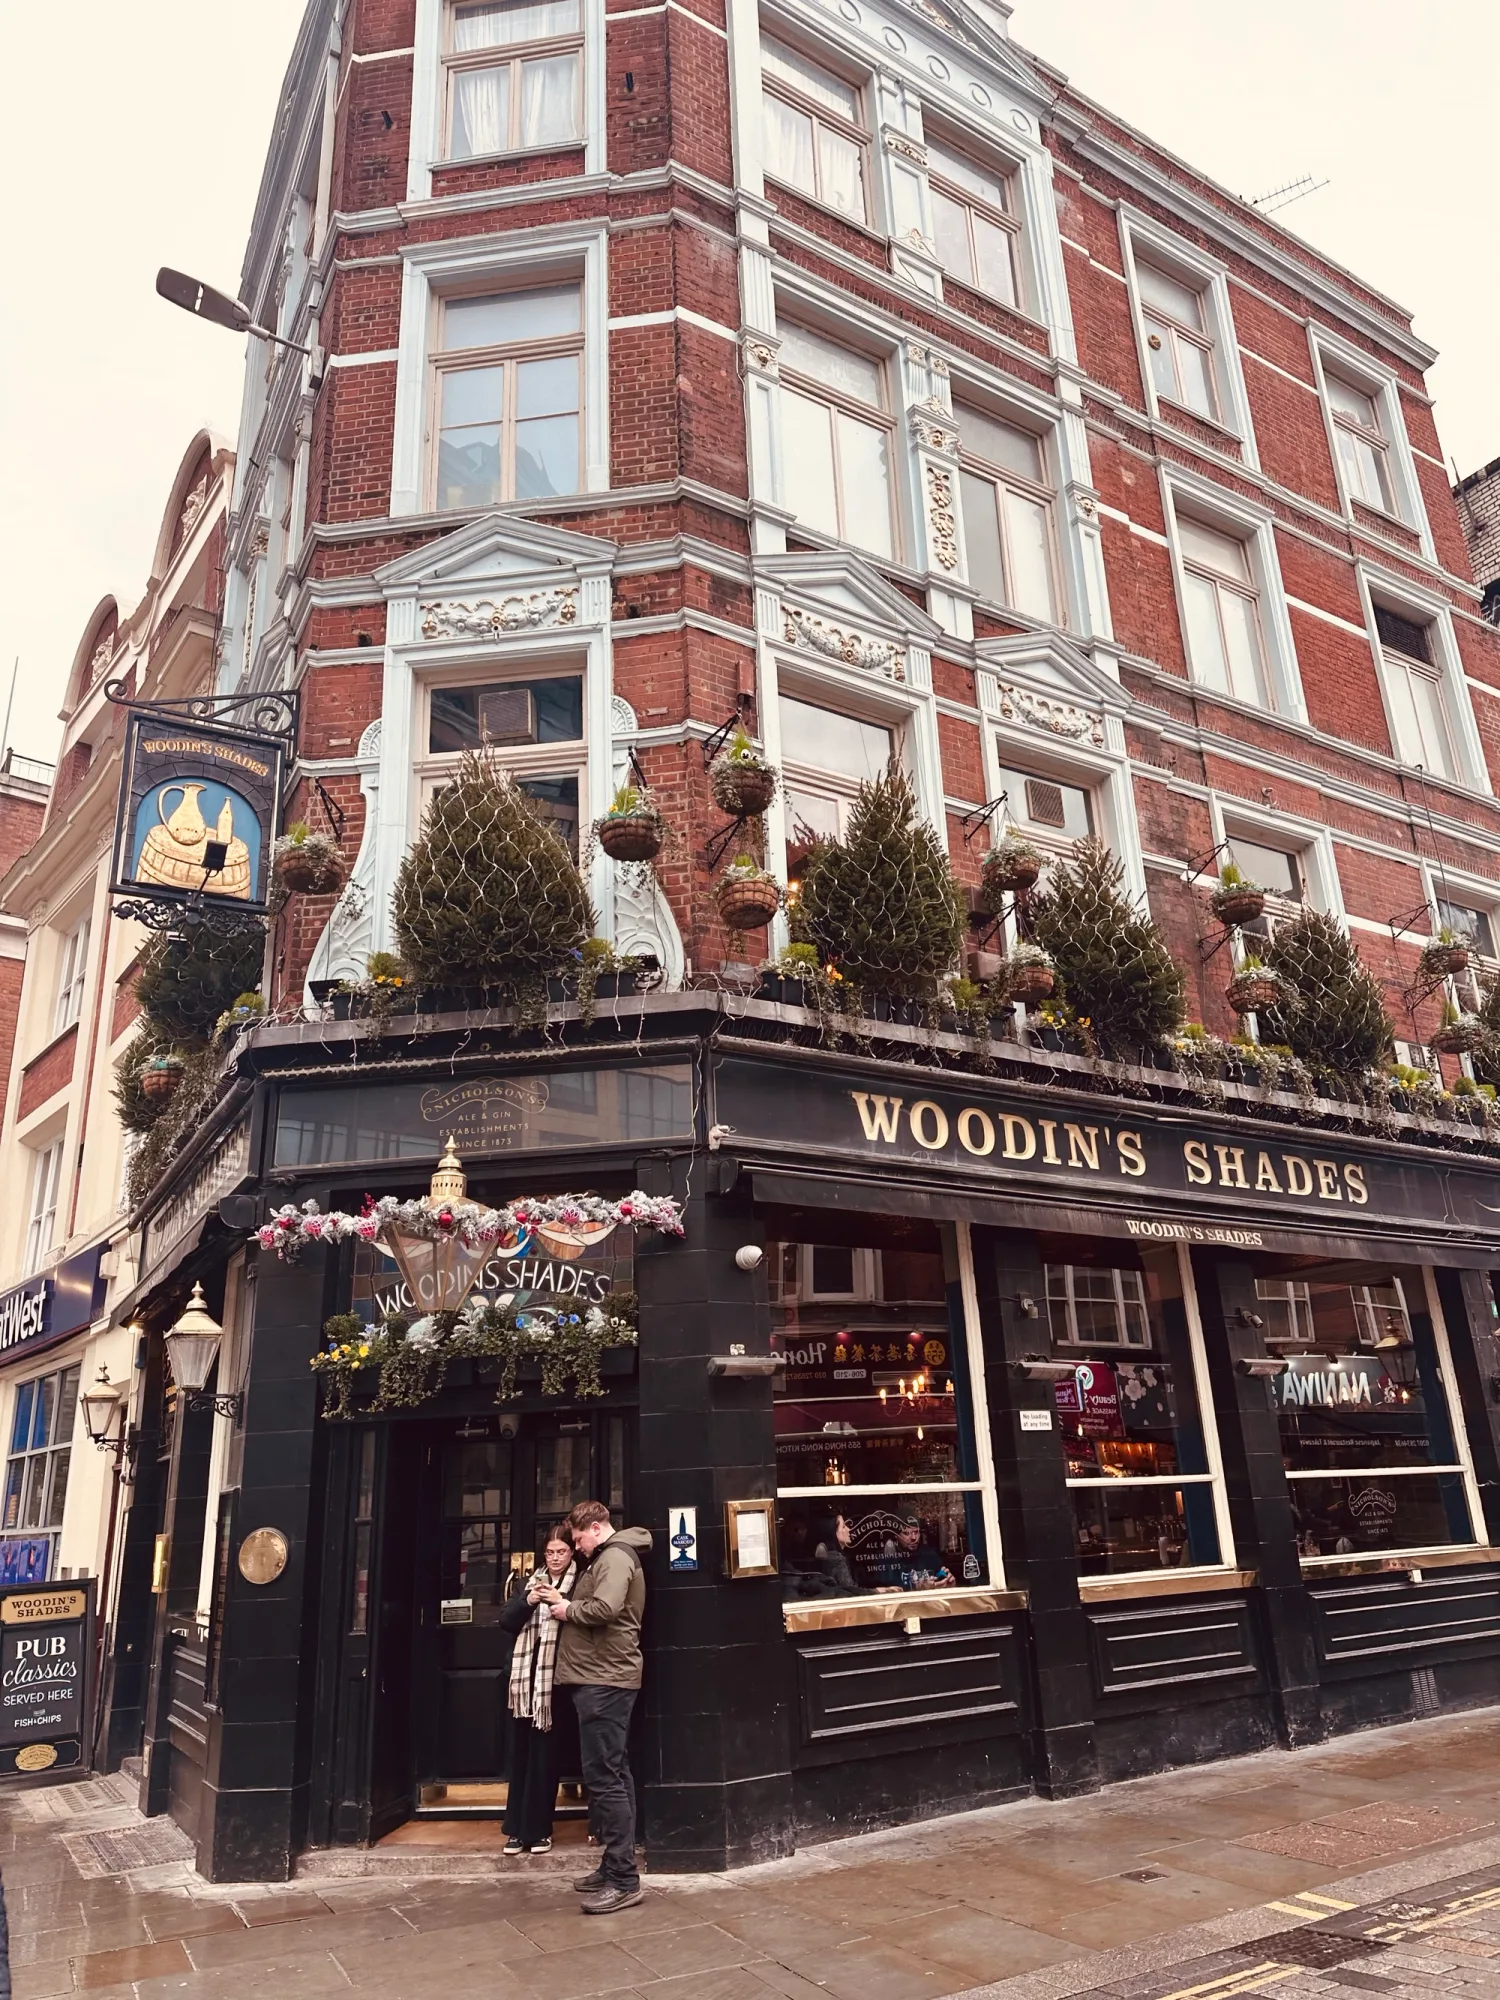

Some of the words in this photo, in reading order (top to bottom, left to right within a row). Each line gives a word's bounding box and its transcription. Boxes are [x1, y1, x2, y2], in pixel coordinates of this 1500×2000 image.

[142, 739, 212, 755] WOODIN'S
[214, 746, 269, 777] SHADES
[433, 1087, 537, 1112] NICHOLSON'S
[458, 1113, 476, 1121] ALE
[481, 1112, 487, 1120] &
[492, 1111, 511, 1119] GIN
[439, 1123, 529, 1136] ESTABLISHMENTS
[456, 1140, 487, 1149] SINCE
[491, 1138, 512, 1146] 1873
[852, 1091, 1147, 1177] WOODIN'S
[1185, 1140, 1369, 1204] SHADES
[1126, 1220, 1204, 1240] WOODIN'S
[1206, 1228, 1263, 1245] SHADES
[504, 1260, 610, 1304] SHADES
[0, 1279, 46, 1349] tWest
[851, 1520, 907, 1540] NICHOLSON
[855, 1552, 910, 1561] ESTABLISHMENTS
[11, 1596, 77, 1609] WOODIN'S
[17, 1606, 70, 1617] SHADES
[15, 1636, 66, 1660] PUB
[2, 1657, 77, 1687] classics
[3, 1692, 44, 1707] SERVED
[47, 1688, 73, 1701] HERE
